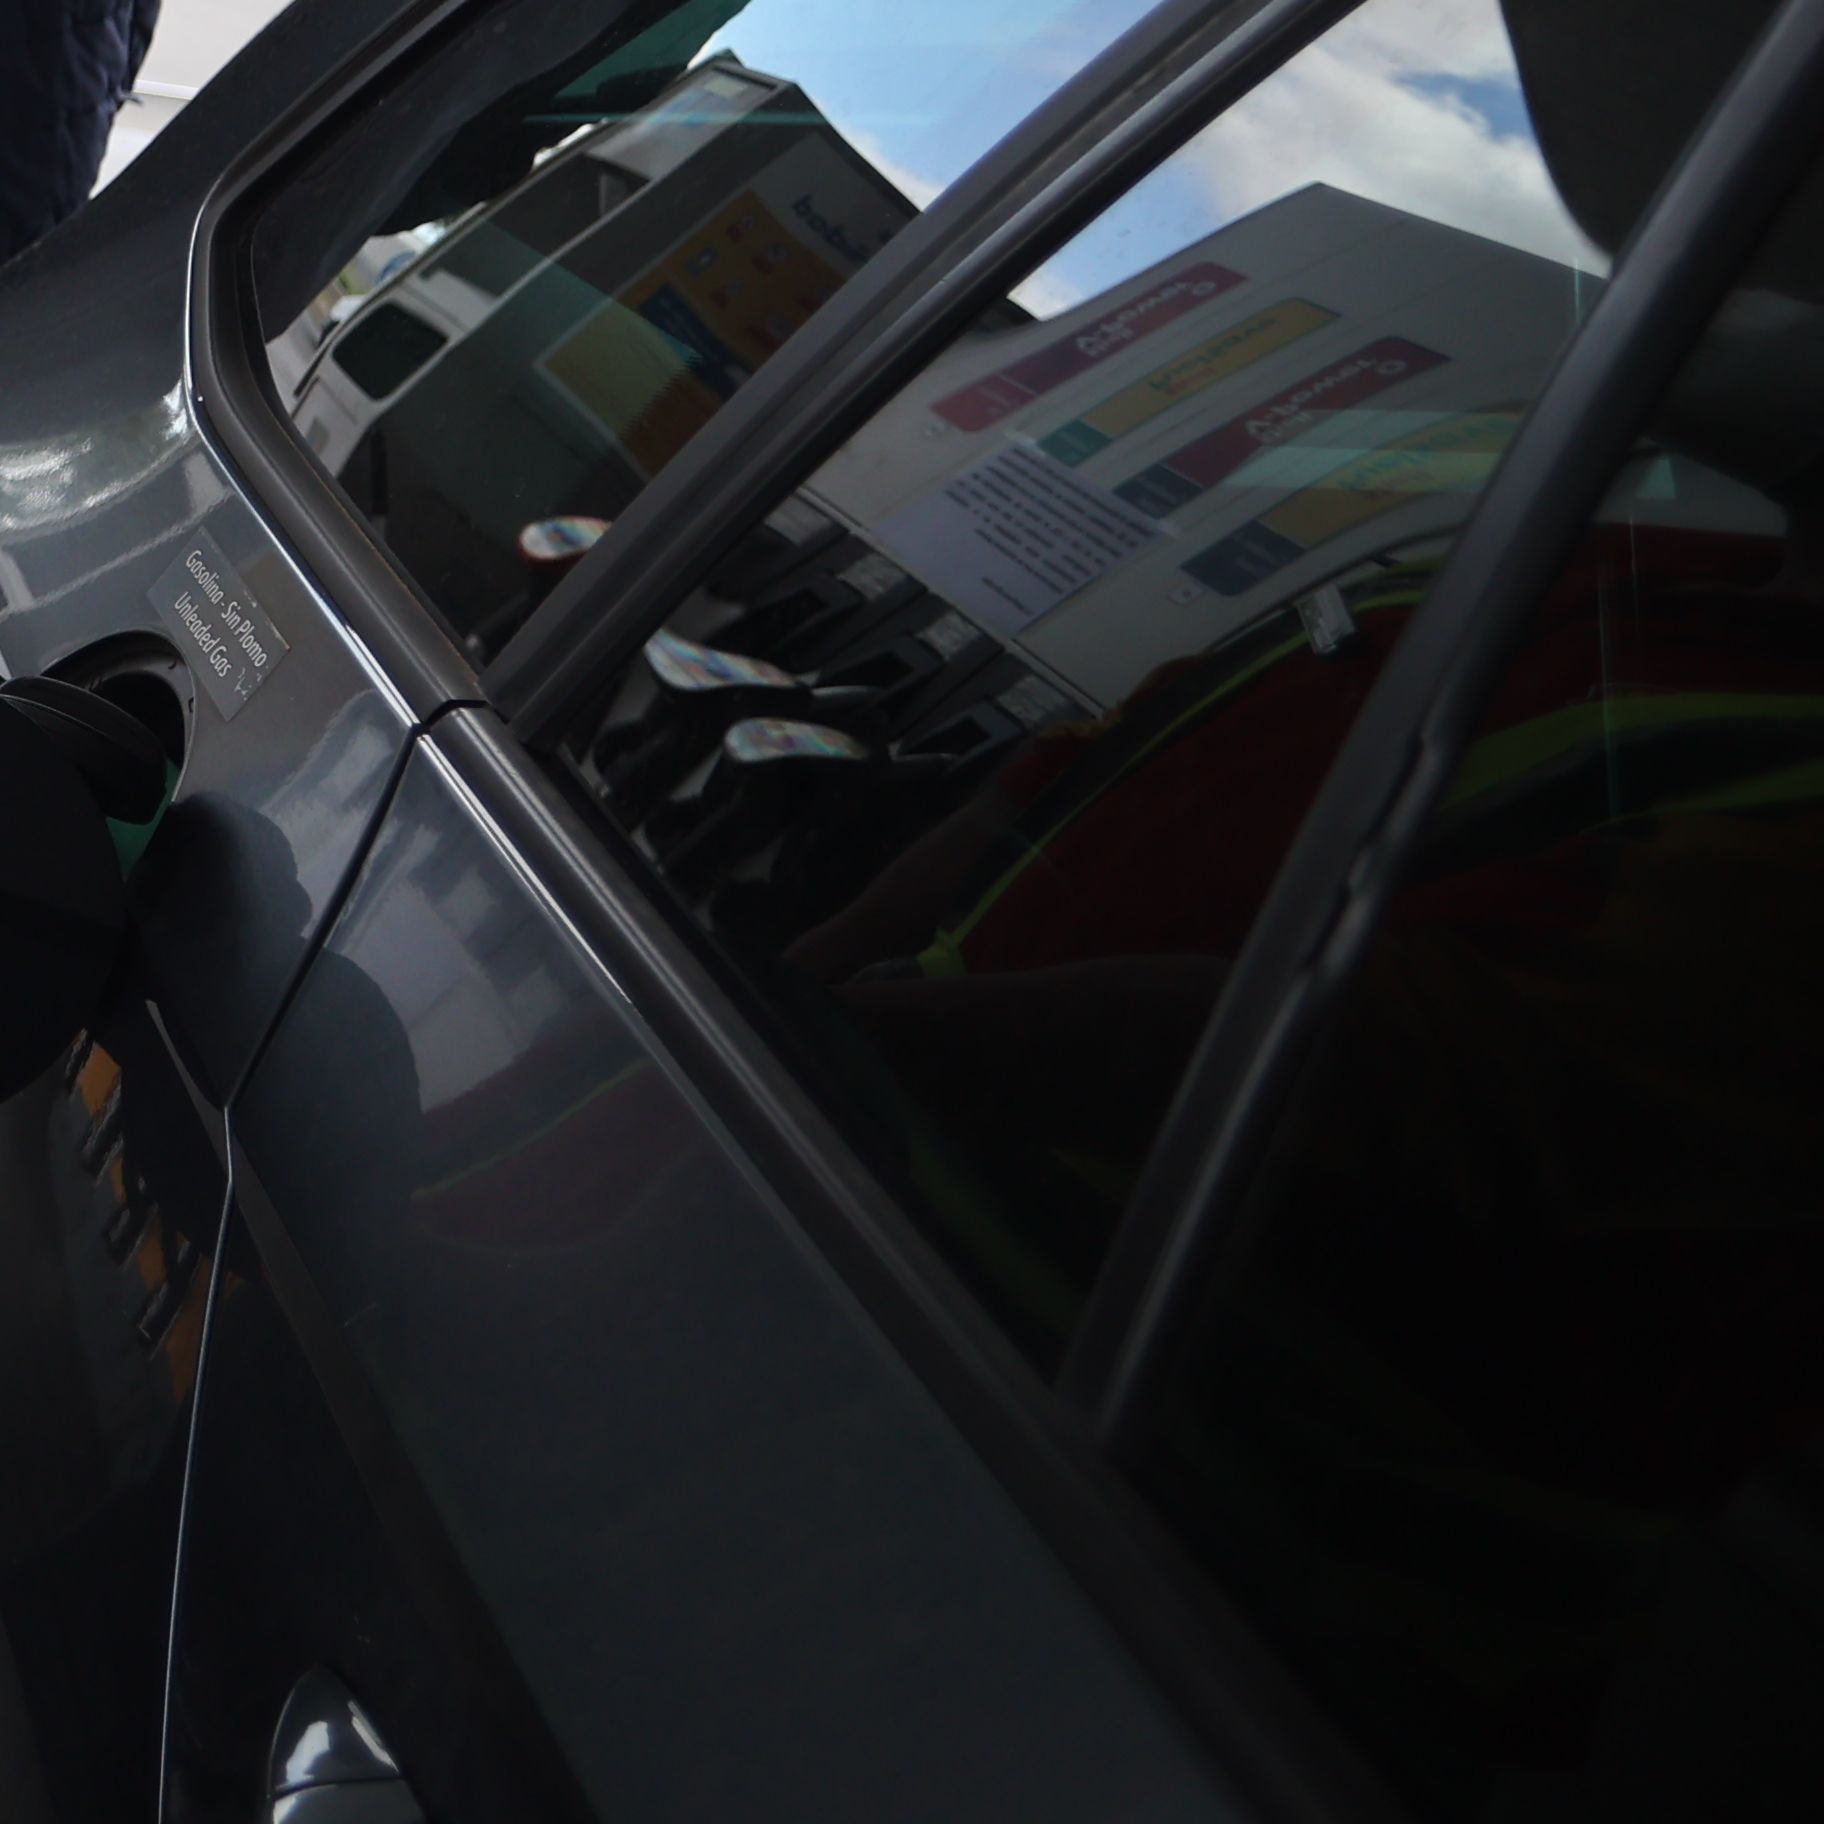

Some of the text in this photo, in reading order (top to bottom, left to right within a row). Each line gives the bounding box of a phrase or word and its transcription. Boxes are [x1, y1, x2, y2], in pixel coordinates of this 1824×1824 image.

[174, 591, 232, 678] Unleaded Gas
[186, 549, 225, 605] Gasolina
[221, 601, 242, 636] Sin
[234, 620, 267, 667] Plomo
